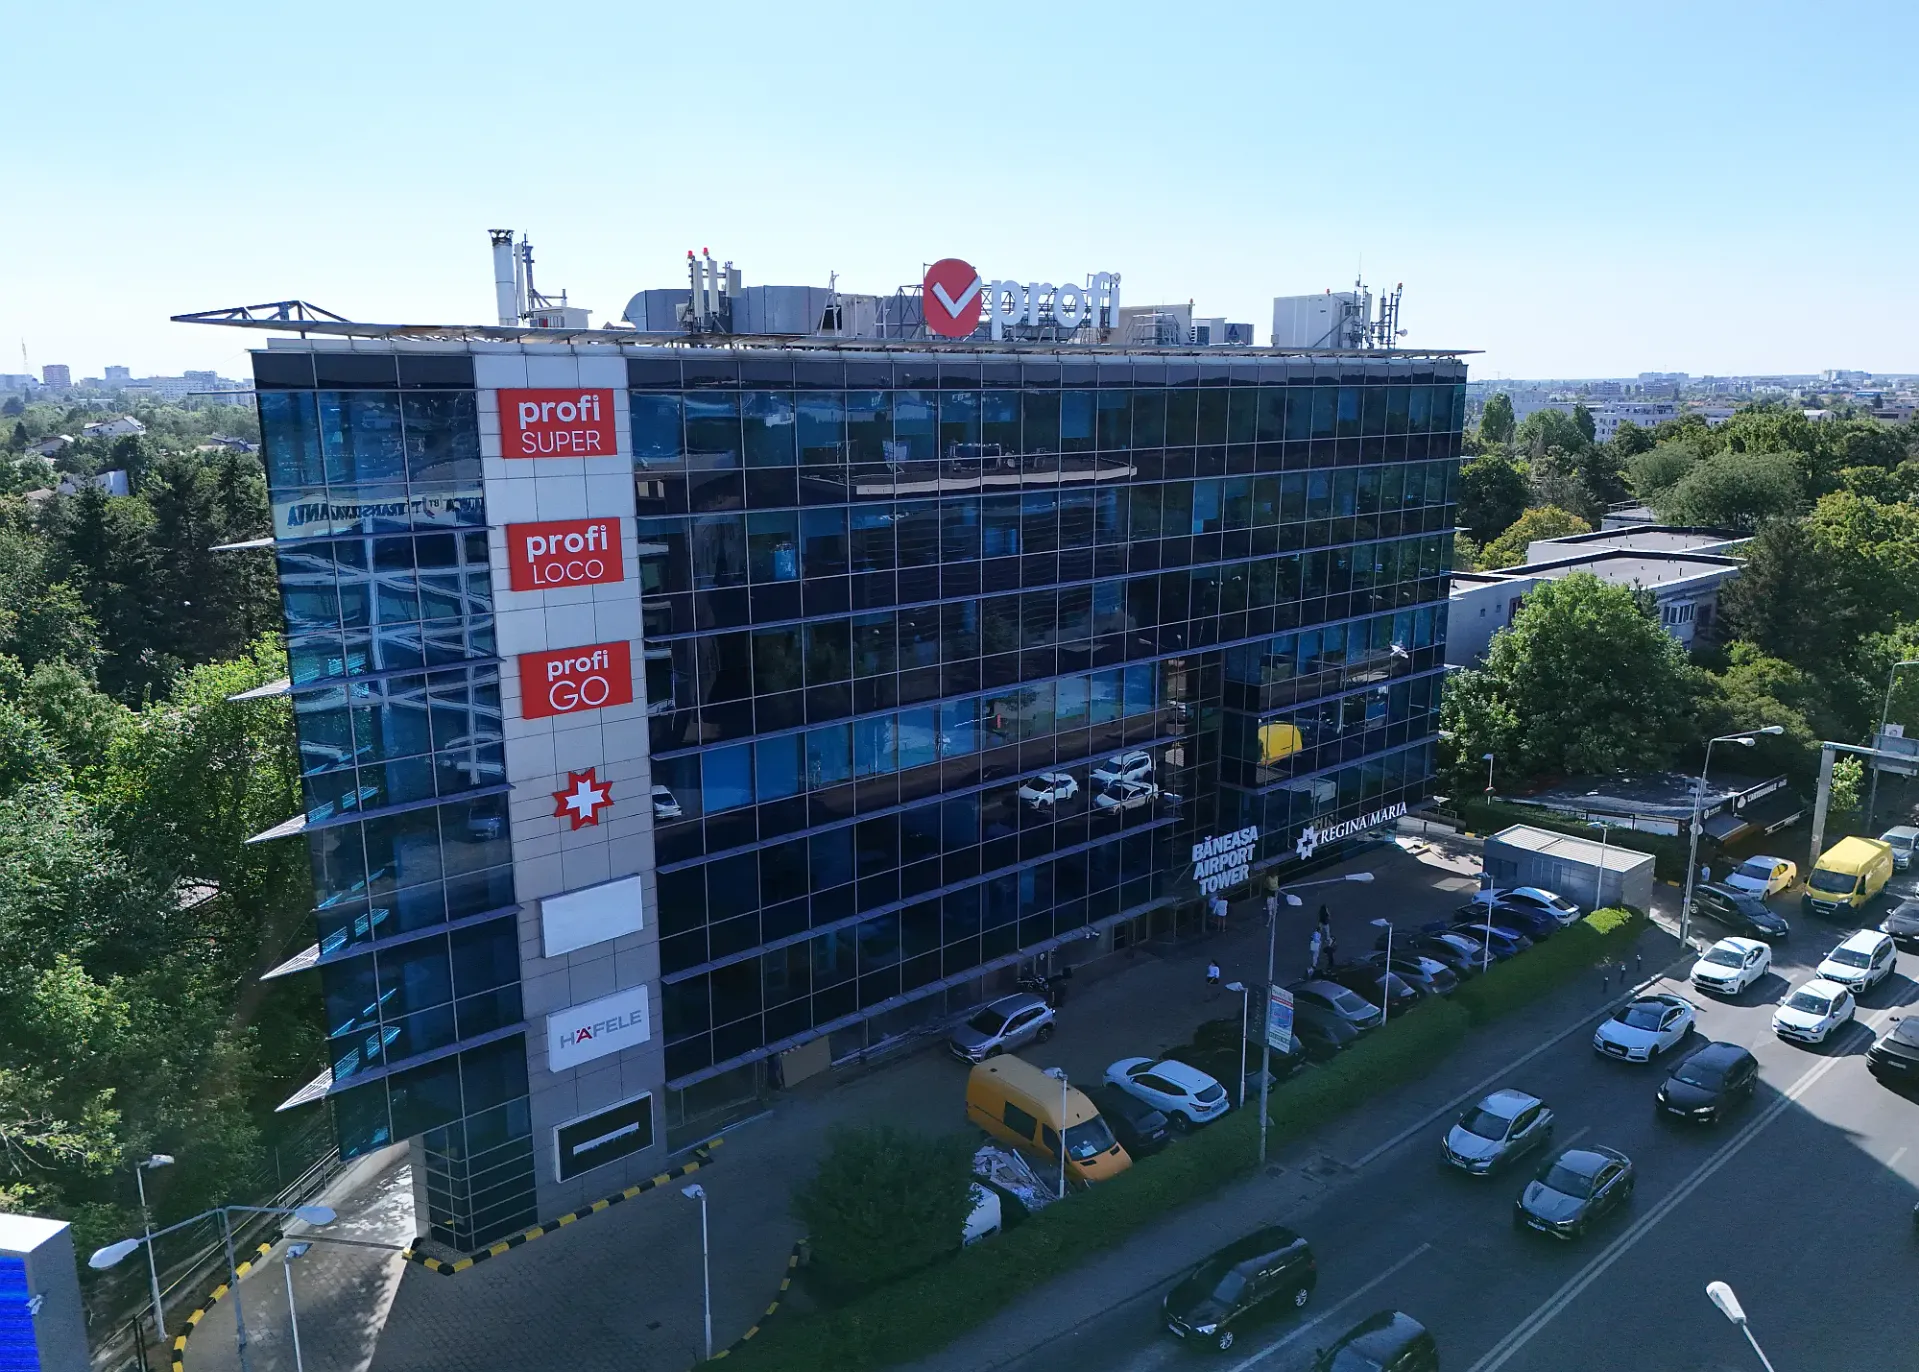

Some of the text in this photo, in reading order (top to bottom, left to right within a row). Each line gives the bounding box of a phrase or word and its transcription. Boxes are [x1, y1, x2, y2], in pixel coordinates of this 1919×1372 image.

[991, 271, 1121, 341] profi
[518, 394, 600, 430] profi
[521, 430, 602, 454] SUPER
[526, 524, 608, 563] profi
[533, 559, 604, 585] LOCO
[547, 649, 609, 682] profi
[549, 675, 610, 711] GO
[1318, 816, 1368, 845] REGINA
[1368, 801, 1408, 828] MARIA
[1192, 825, 1259, 862] BĂNEASA
[1193, 843, 1256, 880] AIRPORT
[1199, 864, 1250, 896] TOWER
[560, 1009, 643, 1049] HÄFELE
